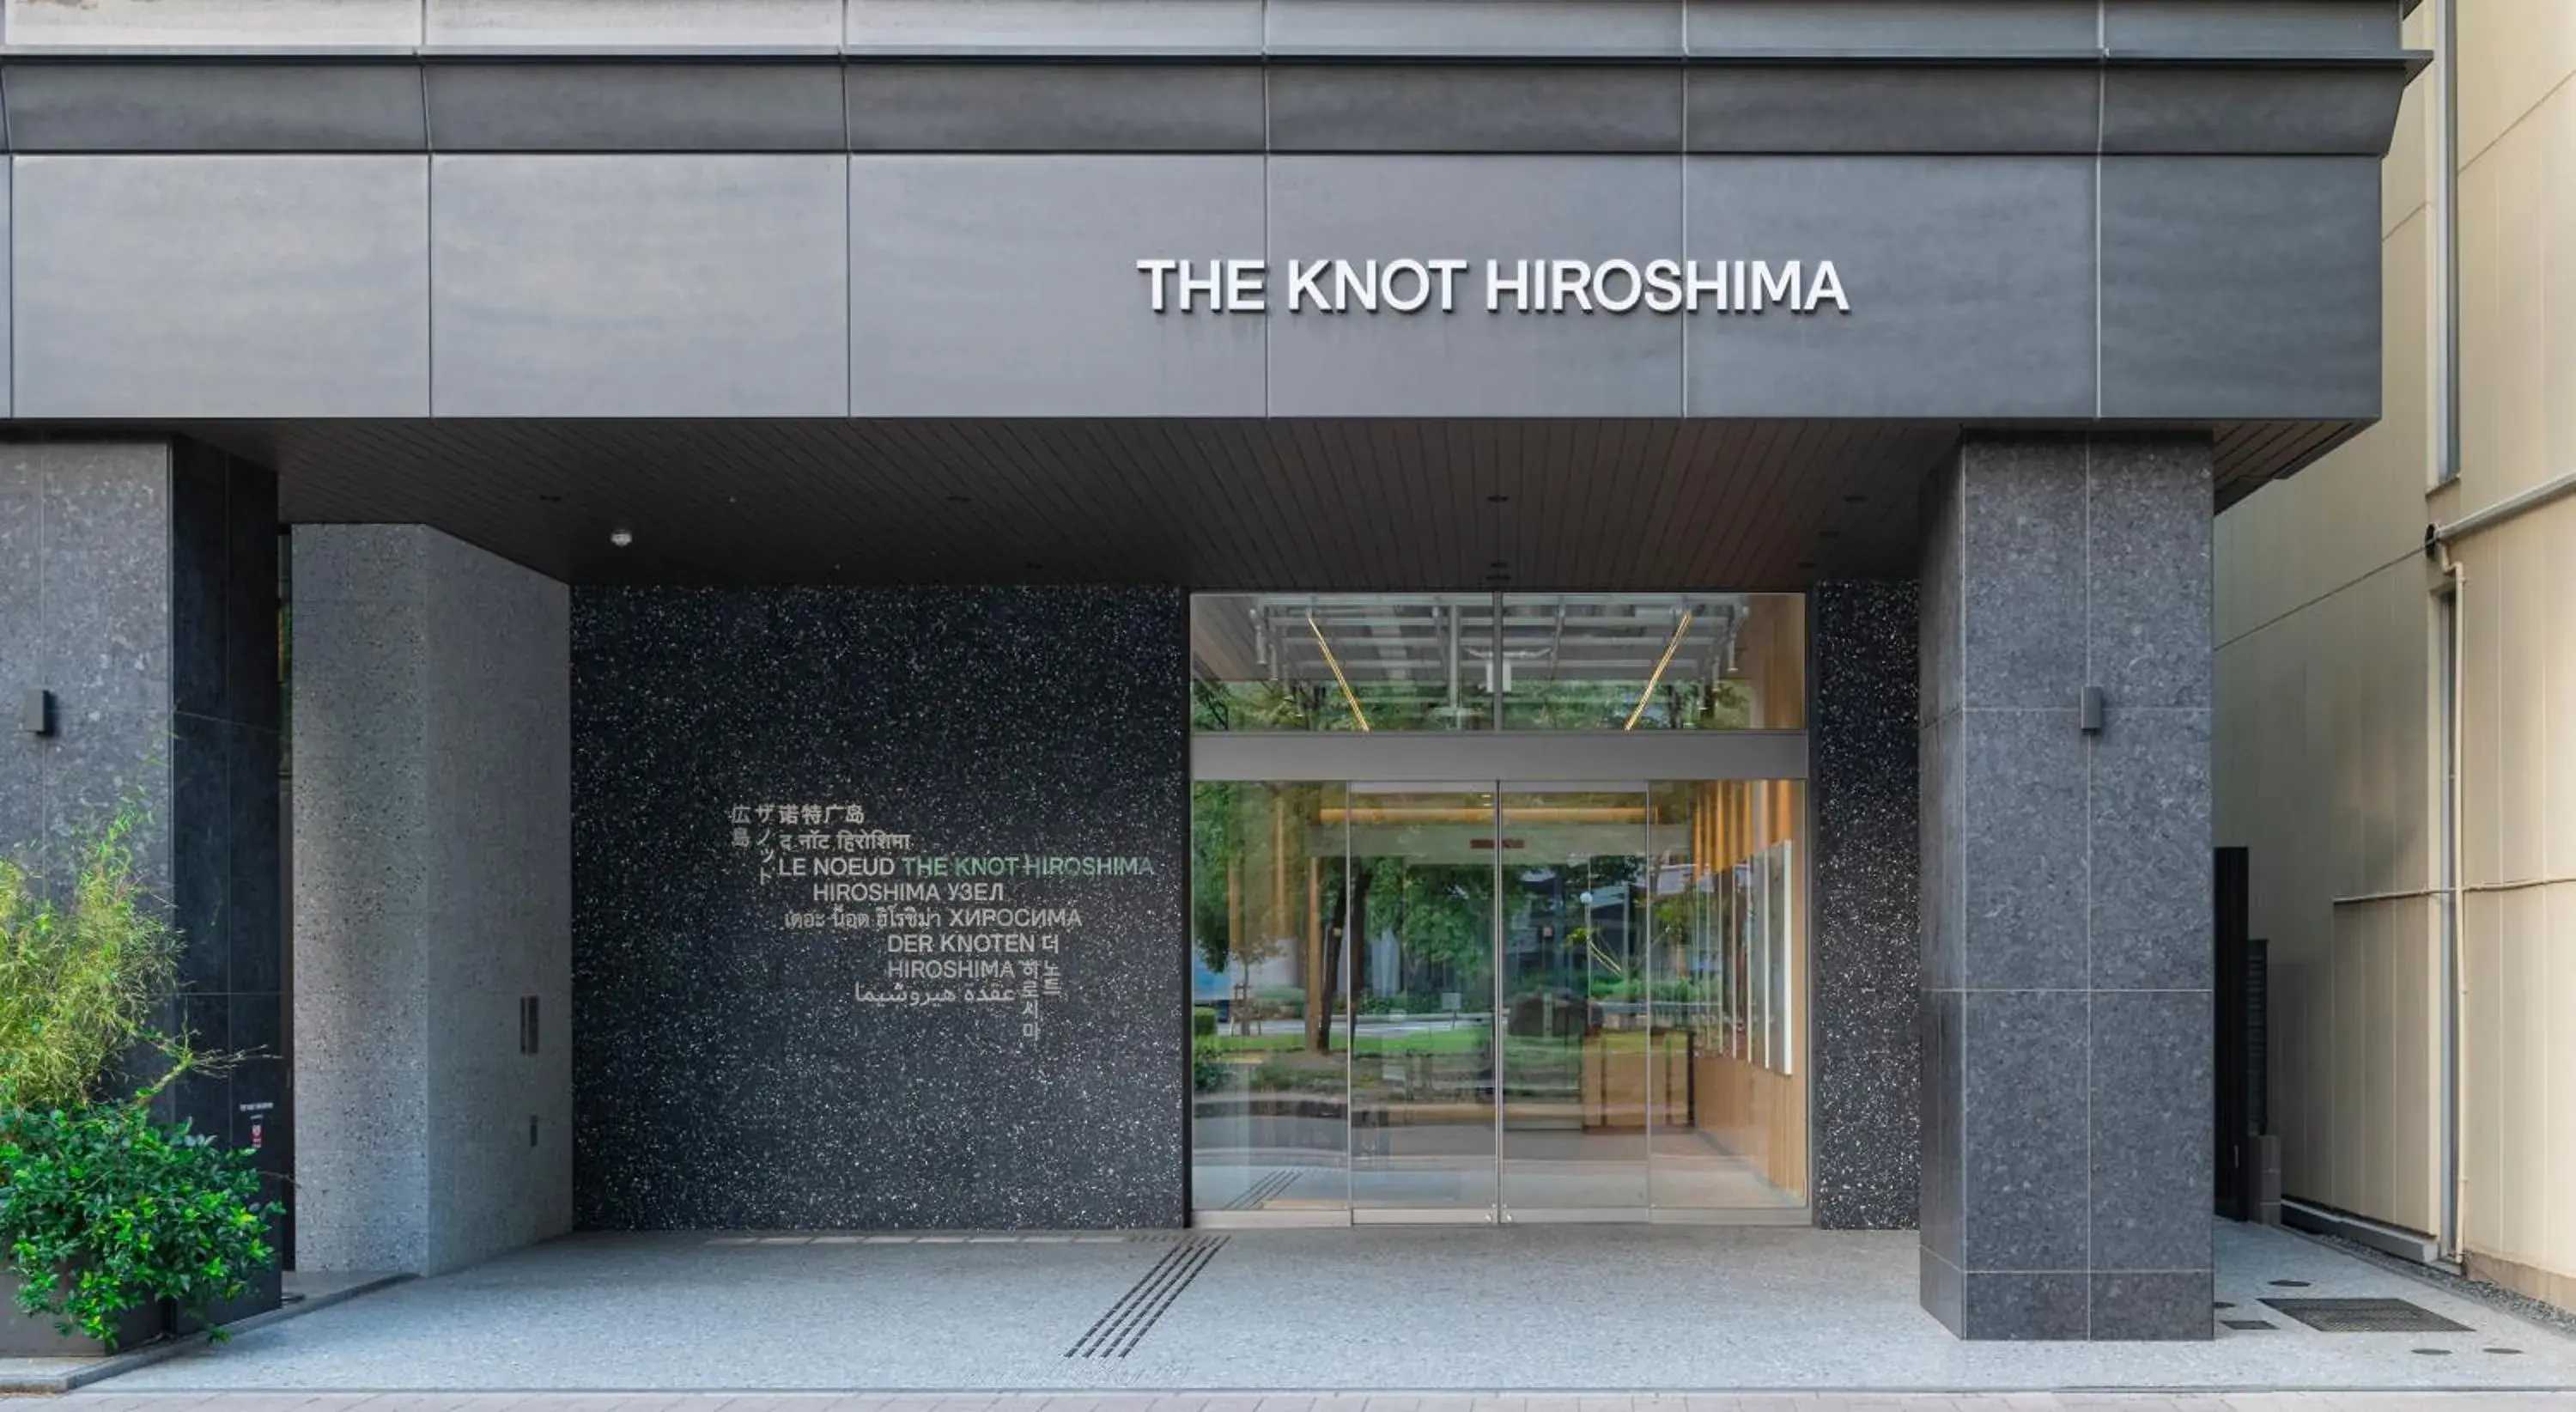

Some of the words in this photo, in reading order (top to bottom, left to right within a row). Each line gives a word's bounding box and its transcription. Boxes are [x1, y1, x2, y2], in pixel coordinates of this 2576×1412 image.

[1137, 259, 1265, 311] THE
[1288, 259, 1467, 311] KNOT
[1487, 259, 1850, 312] HIROSHIMA
[779, 857, 806, 876] LE
[813, 857, 895, 876] NOEUD
[903, 857, 949, 876] THE
[954, 857, 1019, 876] KNOT
[1025, 857, 1155, 876] HIROSHIMA
[814, 883, 940, 902] HIROSHIMA
[948, 883, 1004, 902] УЗЕЛ
[949, 909, 1083, 928] ХИРОСИМА
[887, 934, 933, 953] DER
[941, 934, 1035, 953] KNOTEN
[887, 959, 1015, 979] HIROSHIMA
